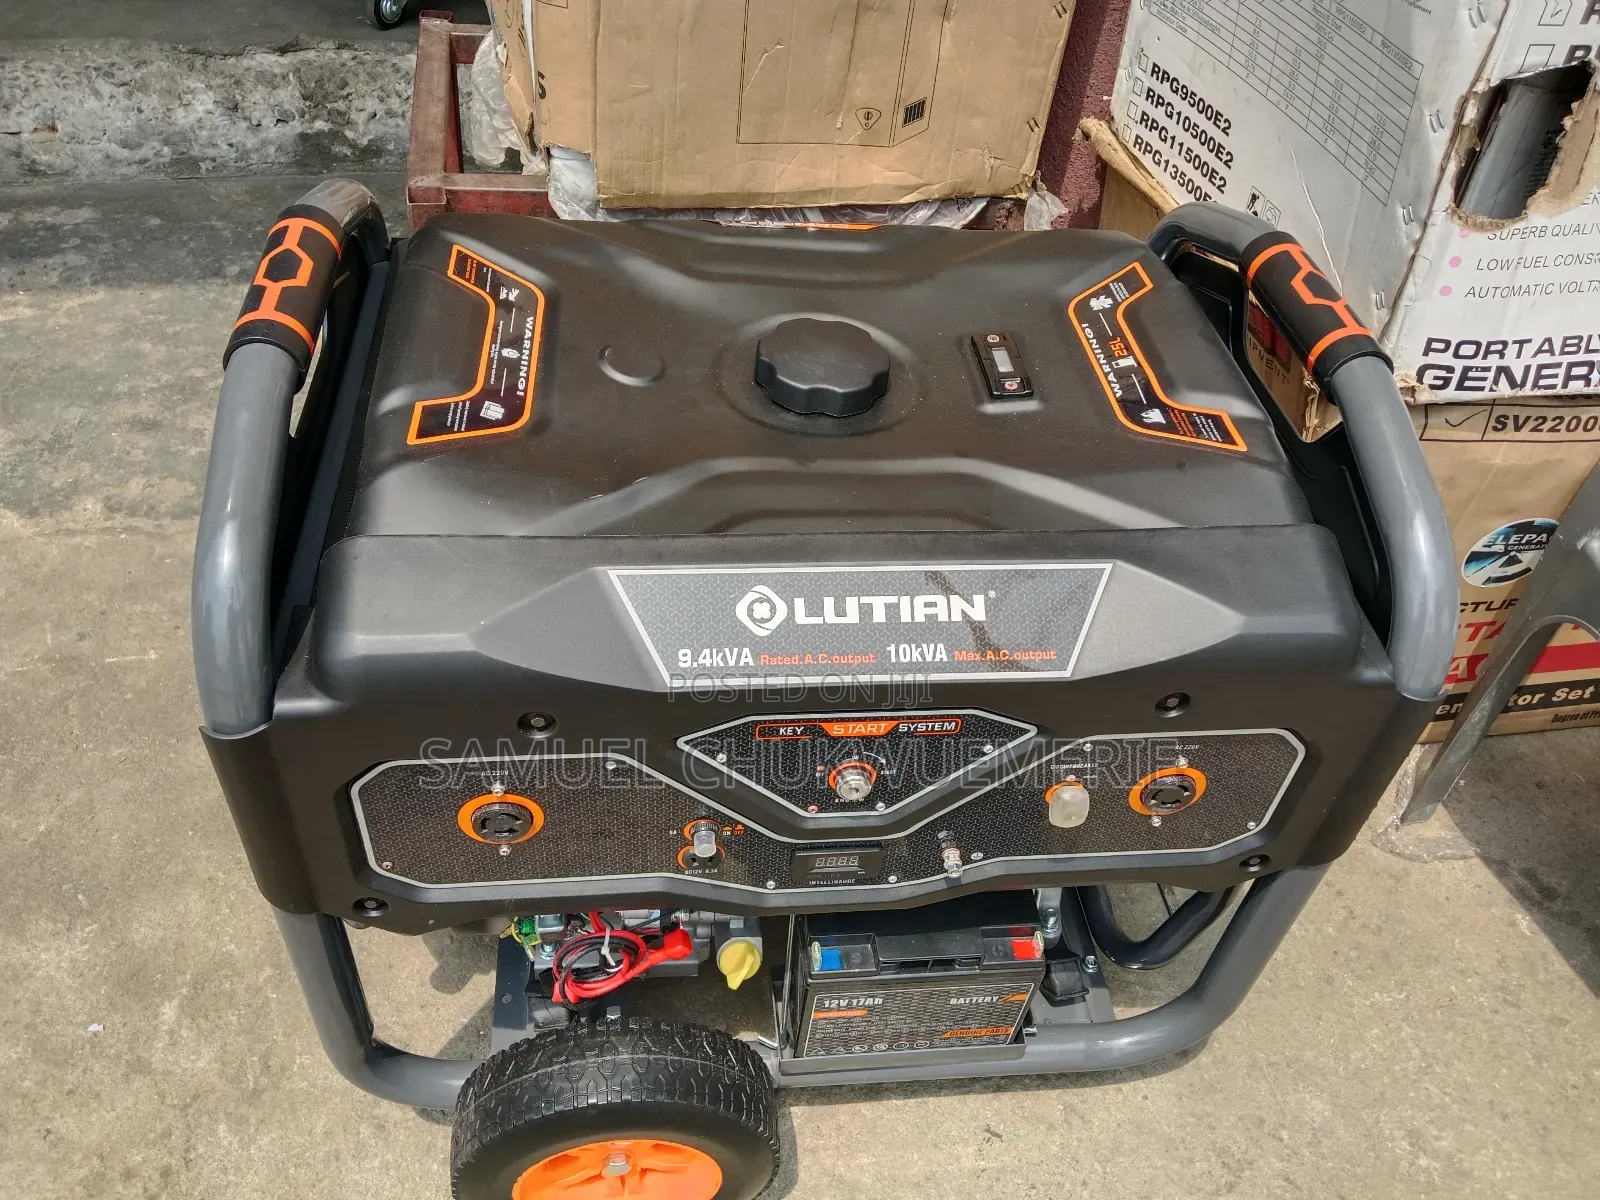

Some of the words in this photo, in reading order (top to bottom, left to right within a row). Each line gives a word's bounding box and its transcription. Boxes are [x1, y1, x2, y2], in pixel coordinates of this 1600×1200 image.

[1150, 61, 1232, 138] RPG9500E2
[1145, 86, 1234, 170] RPG10500E2
[1139, 110, 1227, 194] RPG11500E2
[1132, 133, 1218, 203] RPG13500E
[1551, 222, 1600, 237] QUALI
[1464, 282, 1555, 299] AUTOMATIC
[516, 316, 534, 397] WARNING!
[1081, 323, 1123, 398] WARNING!
[1422, 334, 1600, 361] PORTABL
[1416, 360, 1600, 393] GENER
[1491, 414, 1600, 433] SV2200
[1484, 533, 1549, 546] ELEPA
[794, 594, 987, 625] LUTIAN
[678, 647, 755, 668] 9.4kVA
[886, 643, 949, 663] 10kVA
[1551, 685, 1595, 702] Set
[779, 726, 804, 736] KEY
[832, 723, 888, 735] START
[898, 721, 956, 732] SYSTEM
[823, 999, 848, 1008] 12V
[949, 995, 1000, 1005] BATTERY
